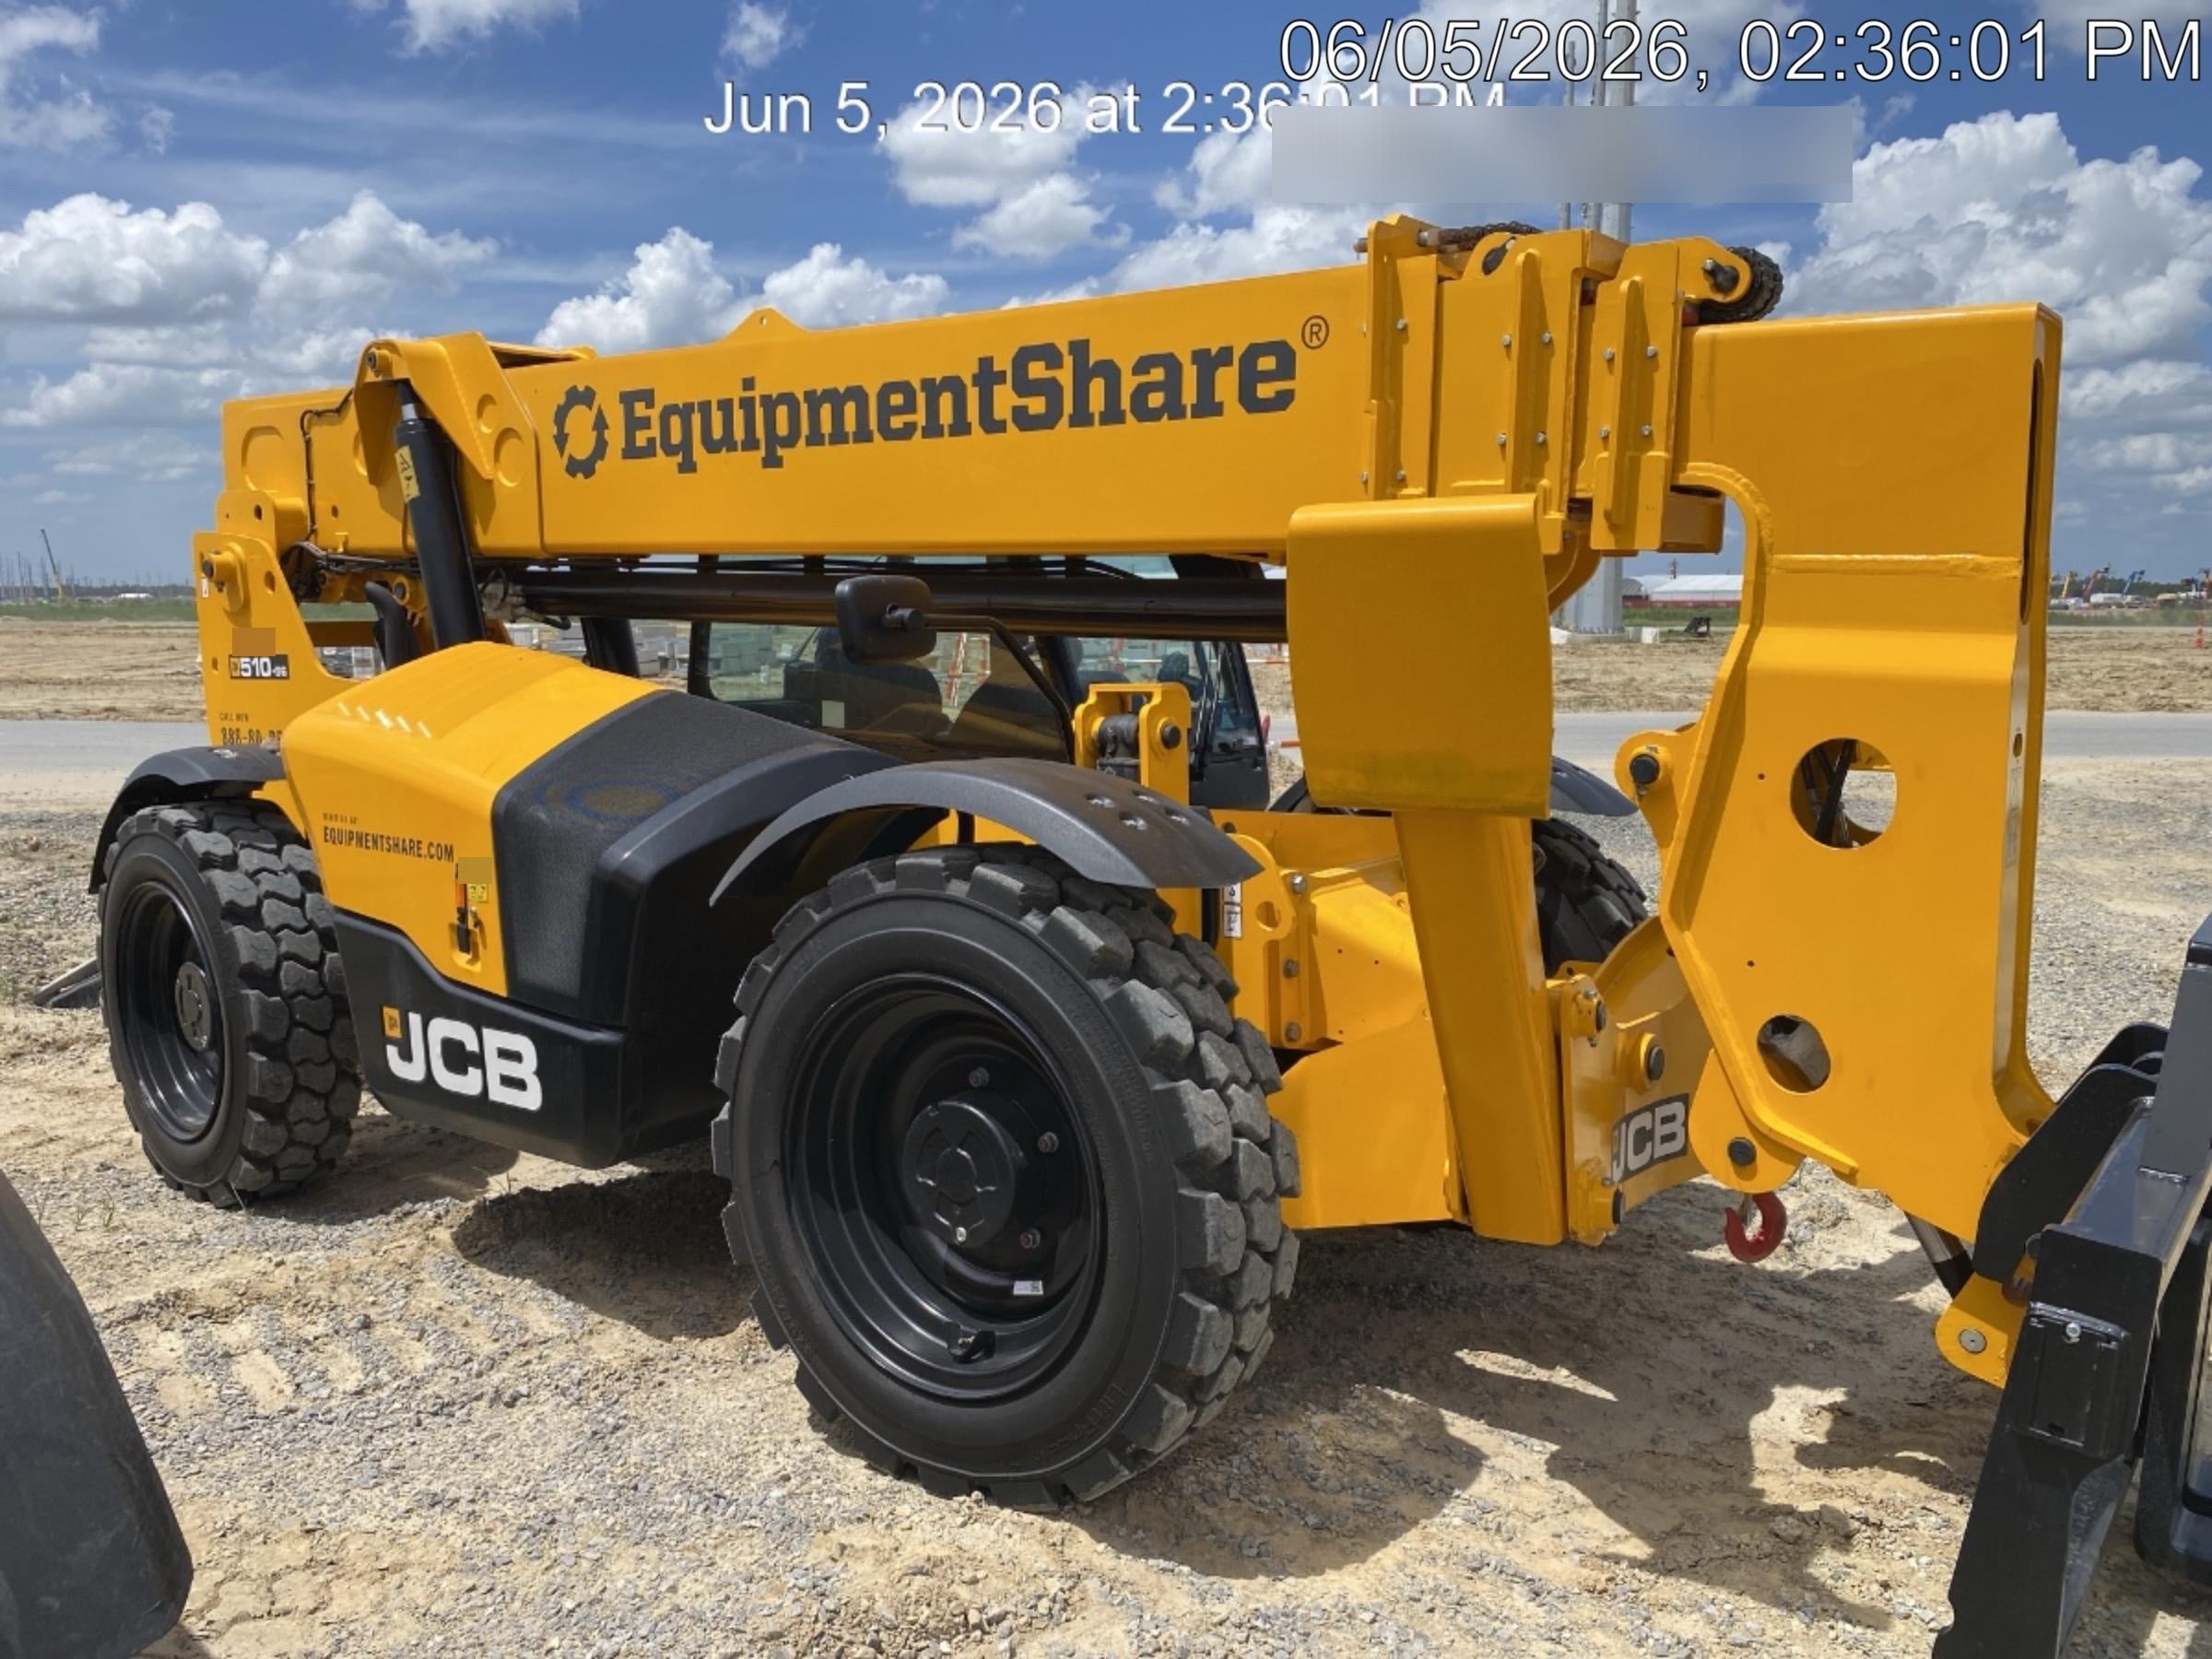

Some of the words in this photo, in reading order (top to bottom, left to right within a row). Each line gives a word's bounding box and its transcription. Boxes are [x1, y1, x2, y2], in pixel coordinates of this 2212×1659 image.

[619, 337, 1298, 474] EquipmentShare
[323, 825, 454, 864] EQUIPMENTSHARE.COM
[385, 1011, 544, 1112] JCB
[1612, 1100, 1687, 1183] JCB
